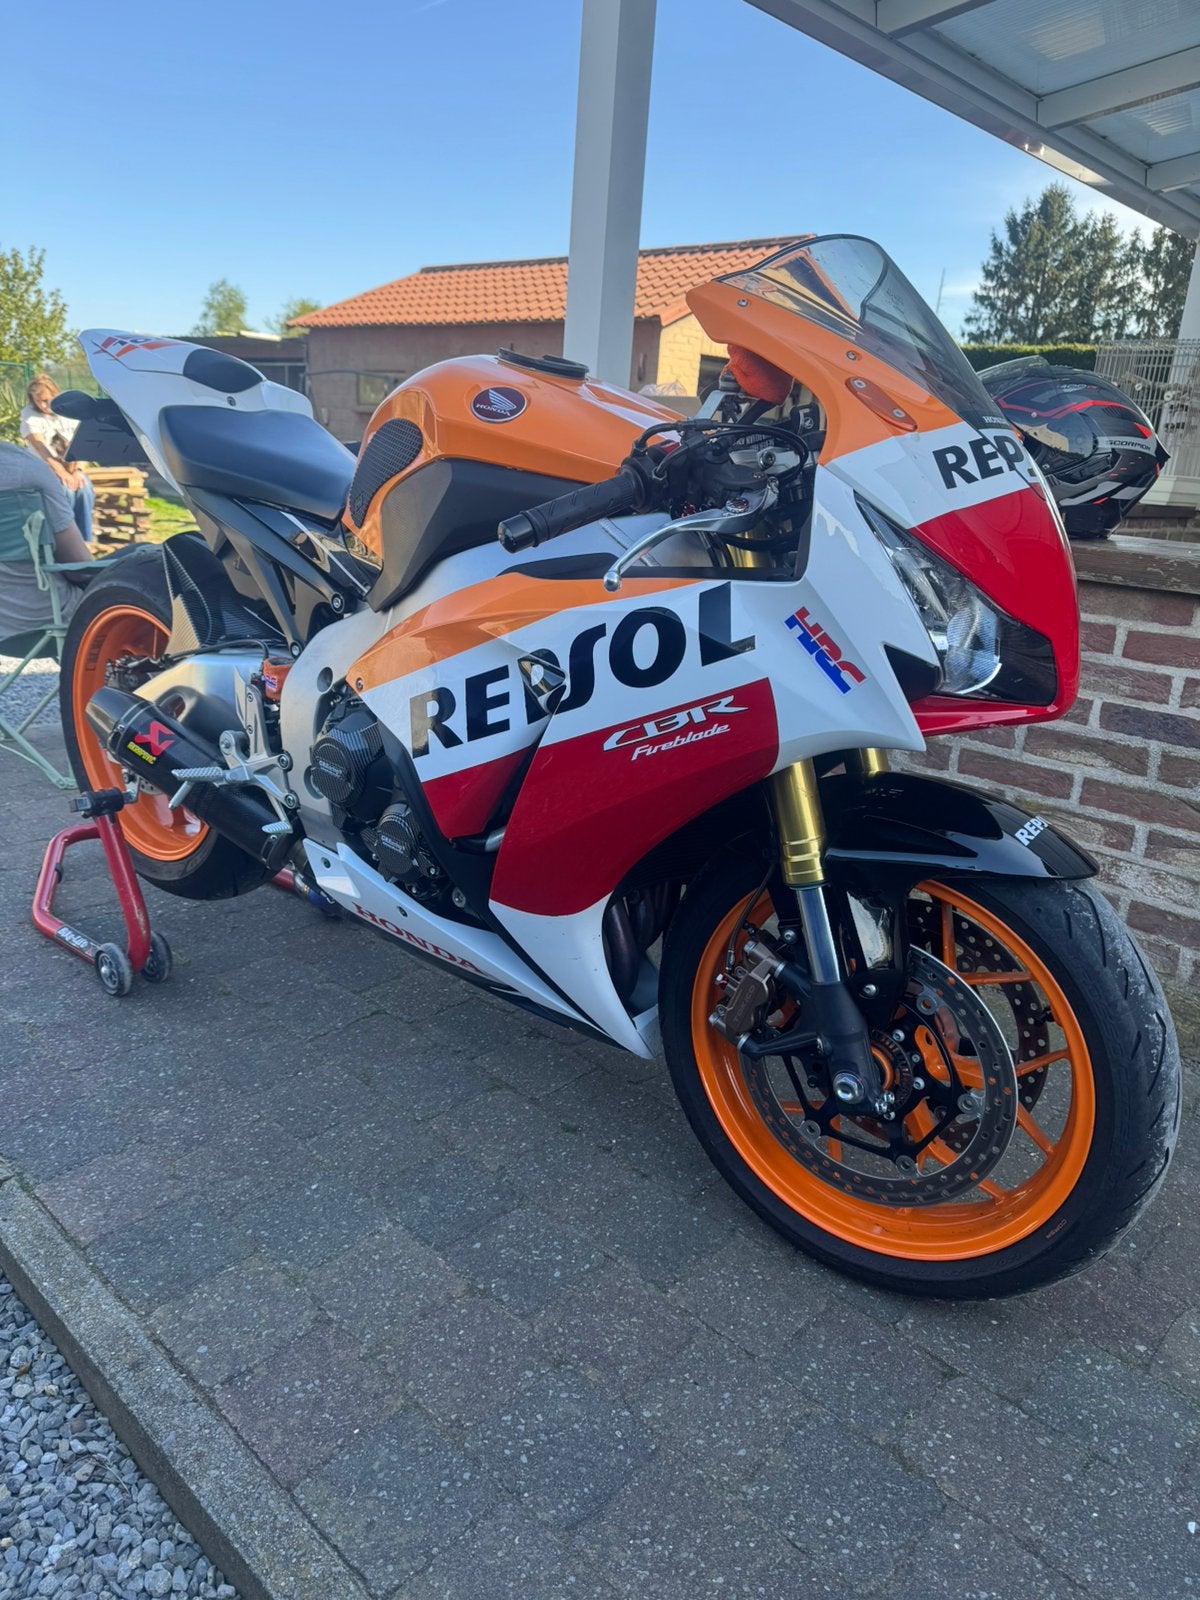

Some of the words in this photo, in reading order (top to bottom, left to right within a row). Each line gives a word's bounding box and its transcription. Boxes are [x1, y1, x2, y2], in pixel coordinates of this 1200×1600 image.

[932, 435, 1037, 489] REP
[784, 606, 867, 694] HRC
[603, 695, 749, 752] CBR
[631, 723, 731, 761] Fireblade
[352, 901, 488, 977] HONDA
